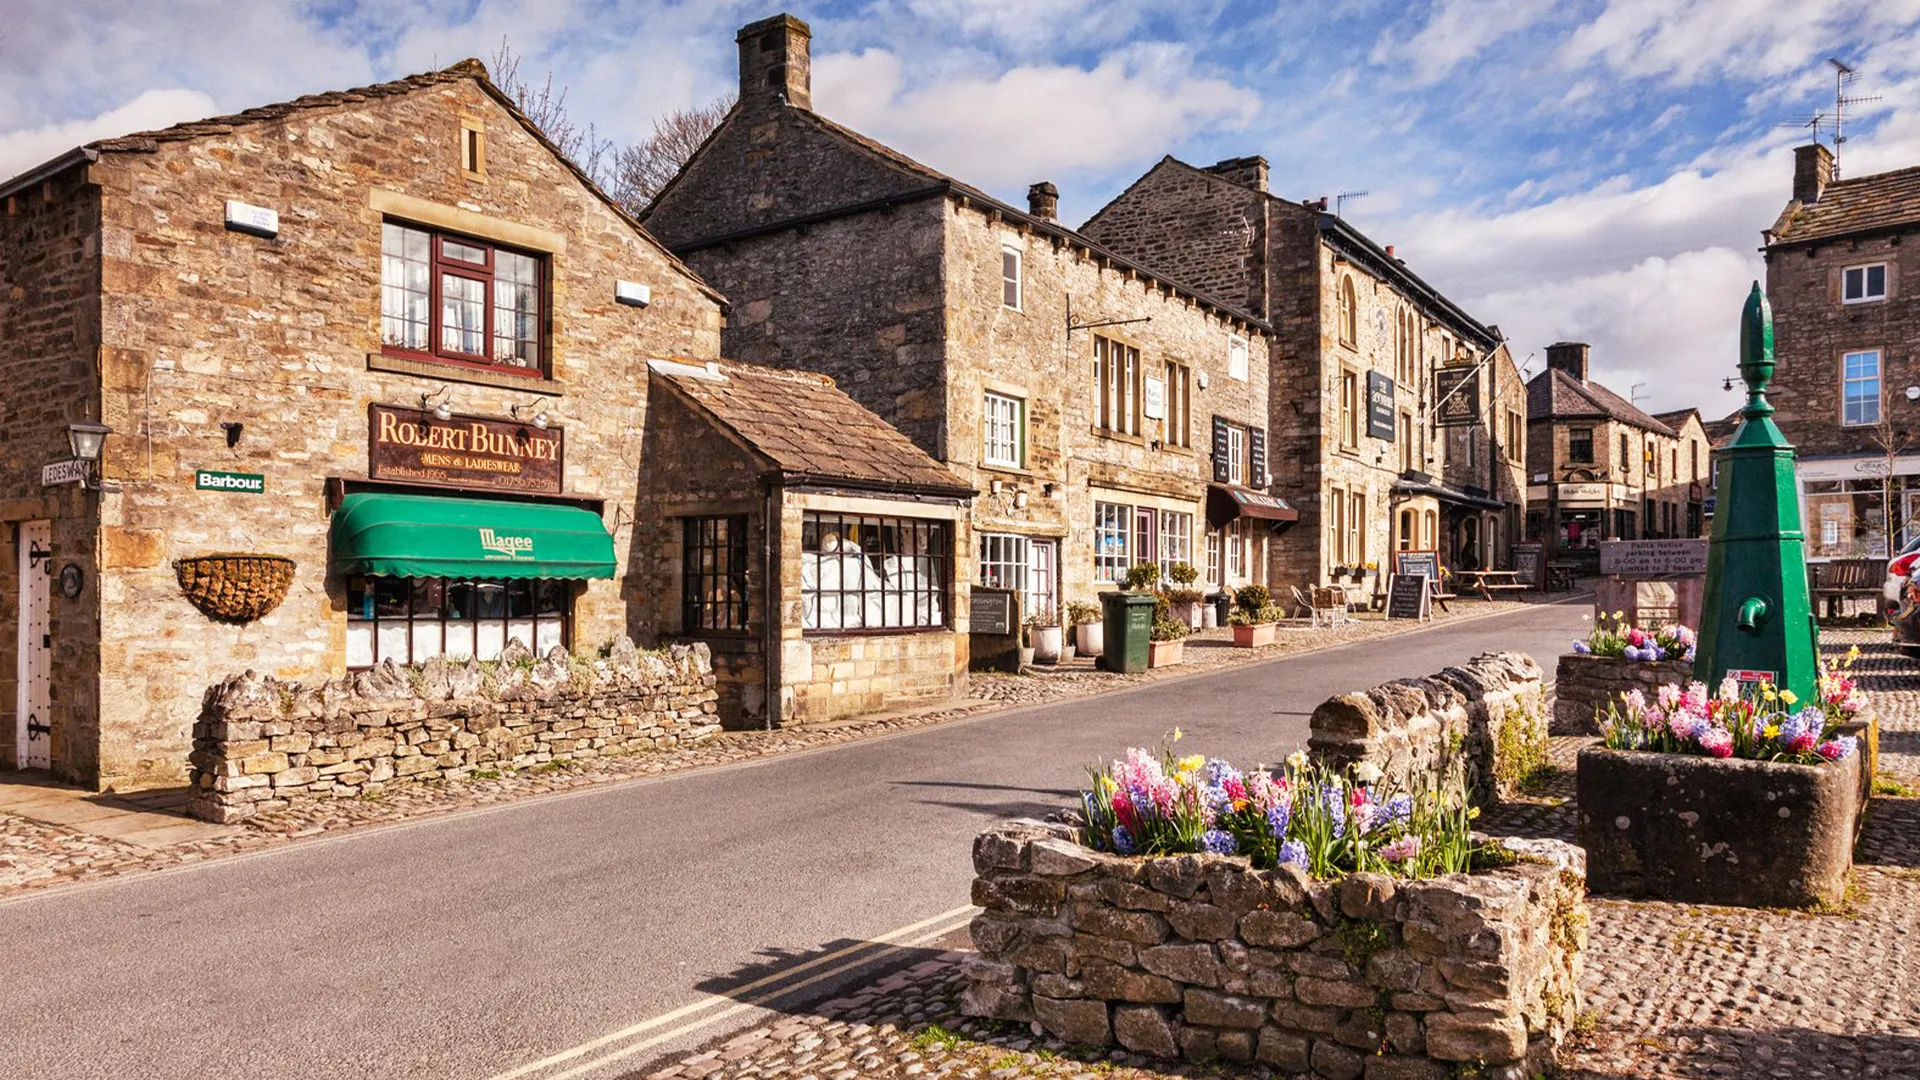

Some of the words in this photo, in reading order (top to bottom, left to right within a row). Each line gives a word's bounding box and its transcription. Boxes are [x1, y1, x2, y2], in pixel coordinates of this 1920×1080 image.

[1440, 377, 1475, 387] DEVONIRE
[378, 412, 468, 451] ROBERT
[471, 423, 560, 461] BUNNEY
[453, 458, 462, 466] &
[378, 464, 424, 478] Established
[479, 528, 533, 557] Magee
